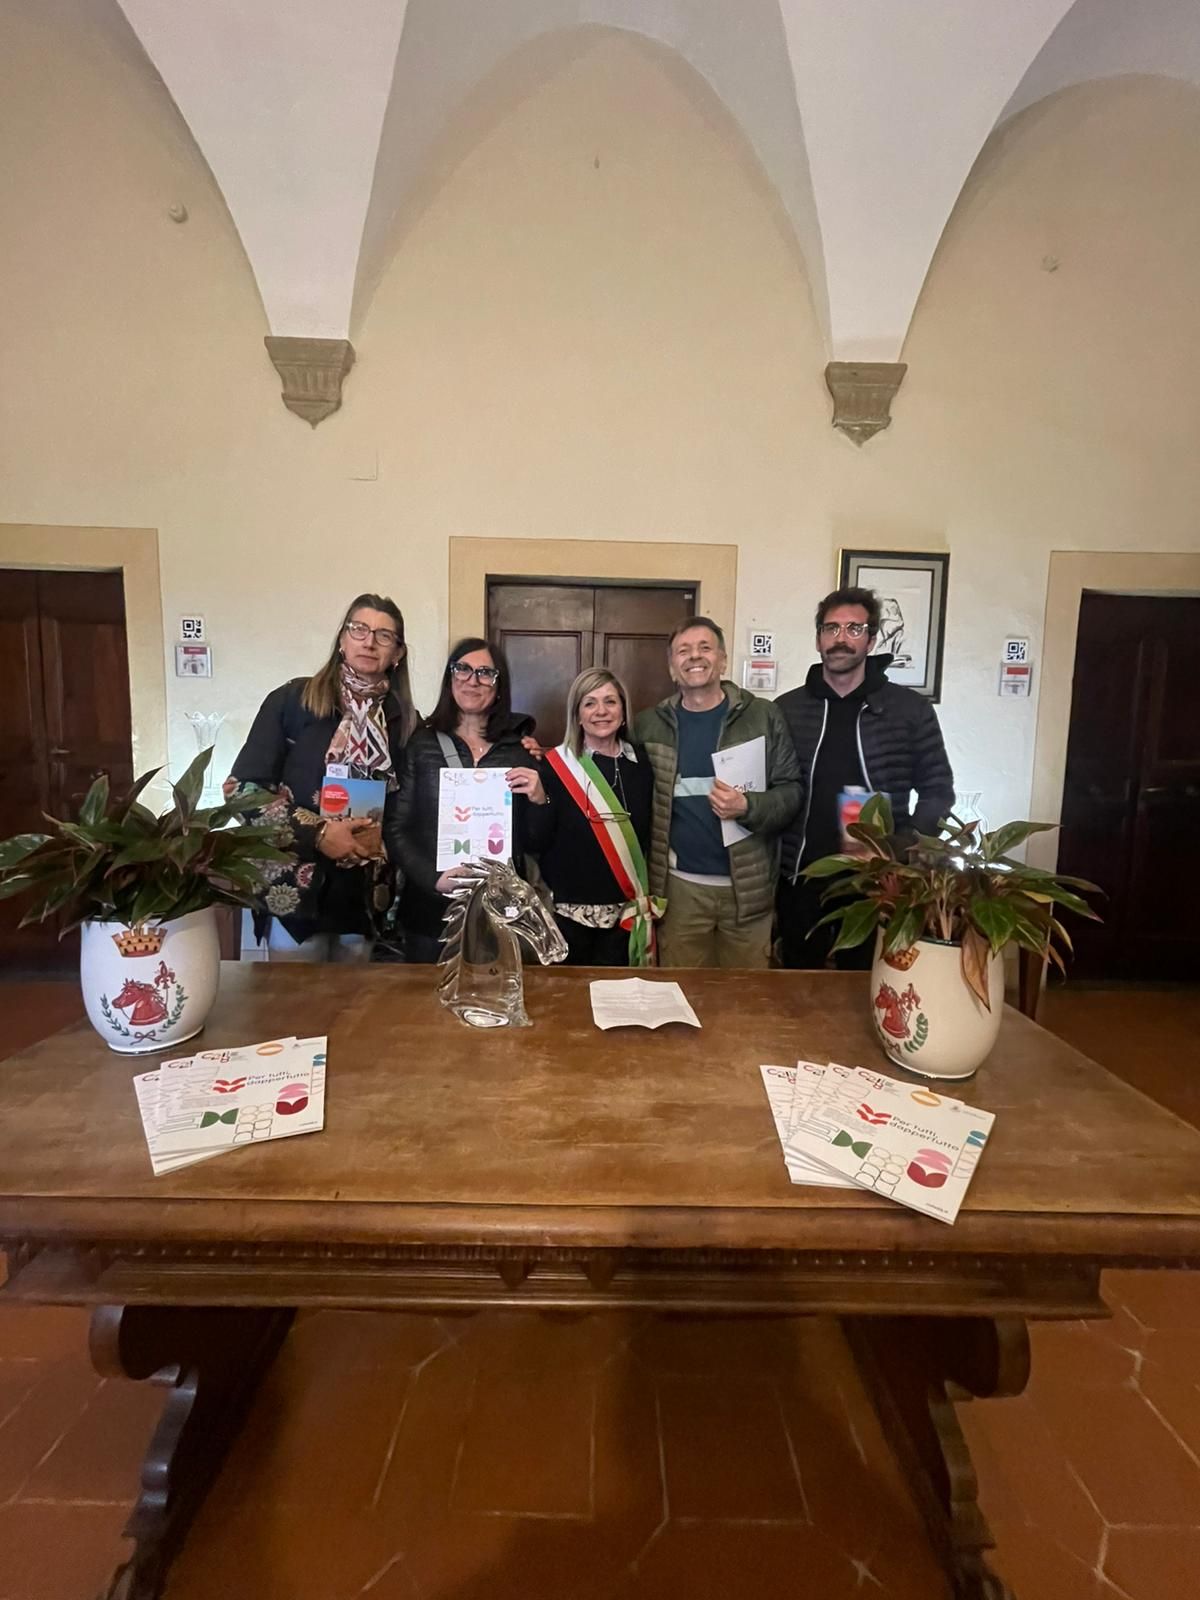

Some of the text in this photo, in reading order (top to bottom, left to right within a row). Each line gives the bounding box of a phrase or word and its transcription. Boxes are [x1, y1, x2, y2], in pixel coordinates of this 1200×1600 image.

[246, 1072, 310, 1086] dappertutto
[892, 1115, 912, 1127] Per
[888, 1121, 960, 1151] dappertutto
